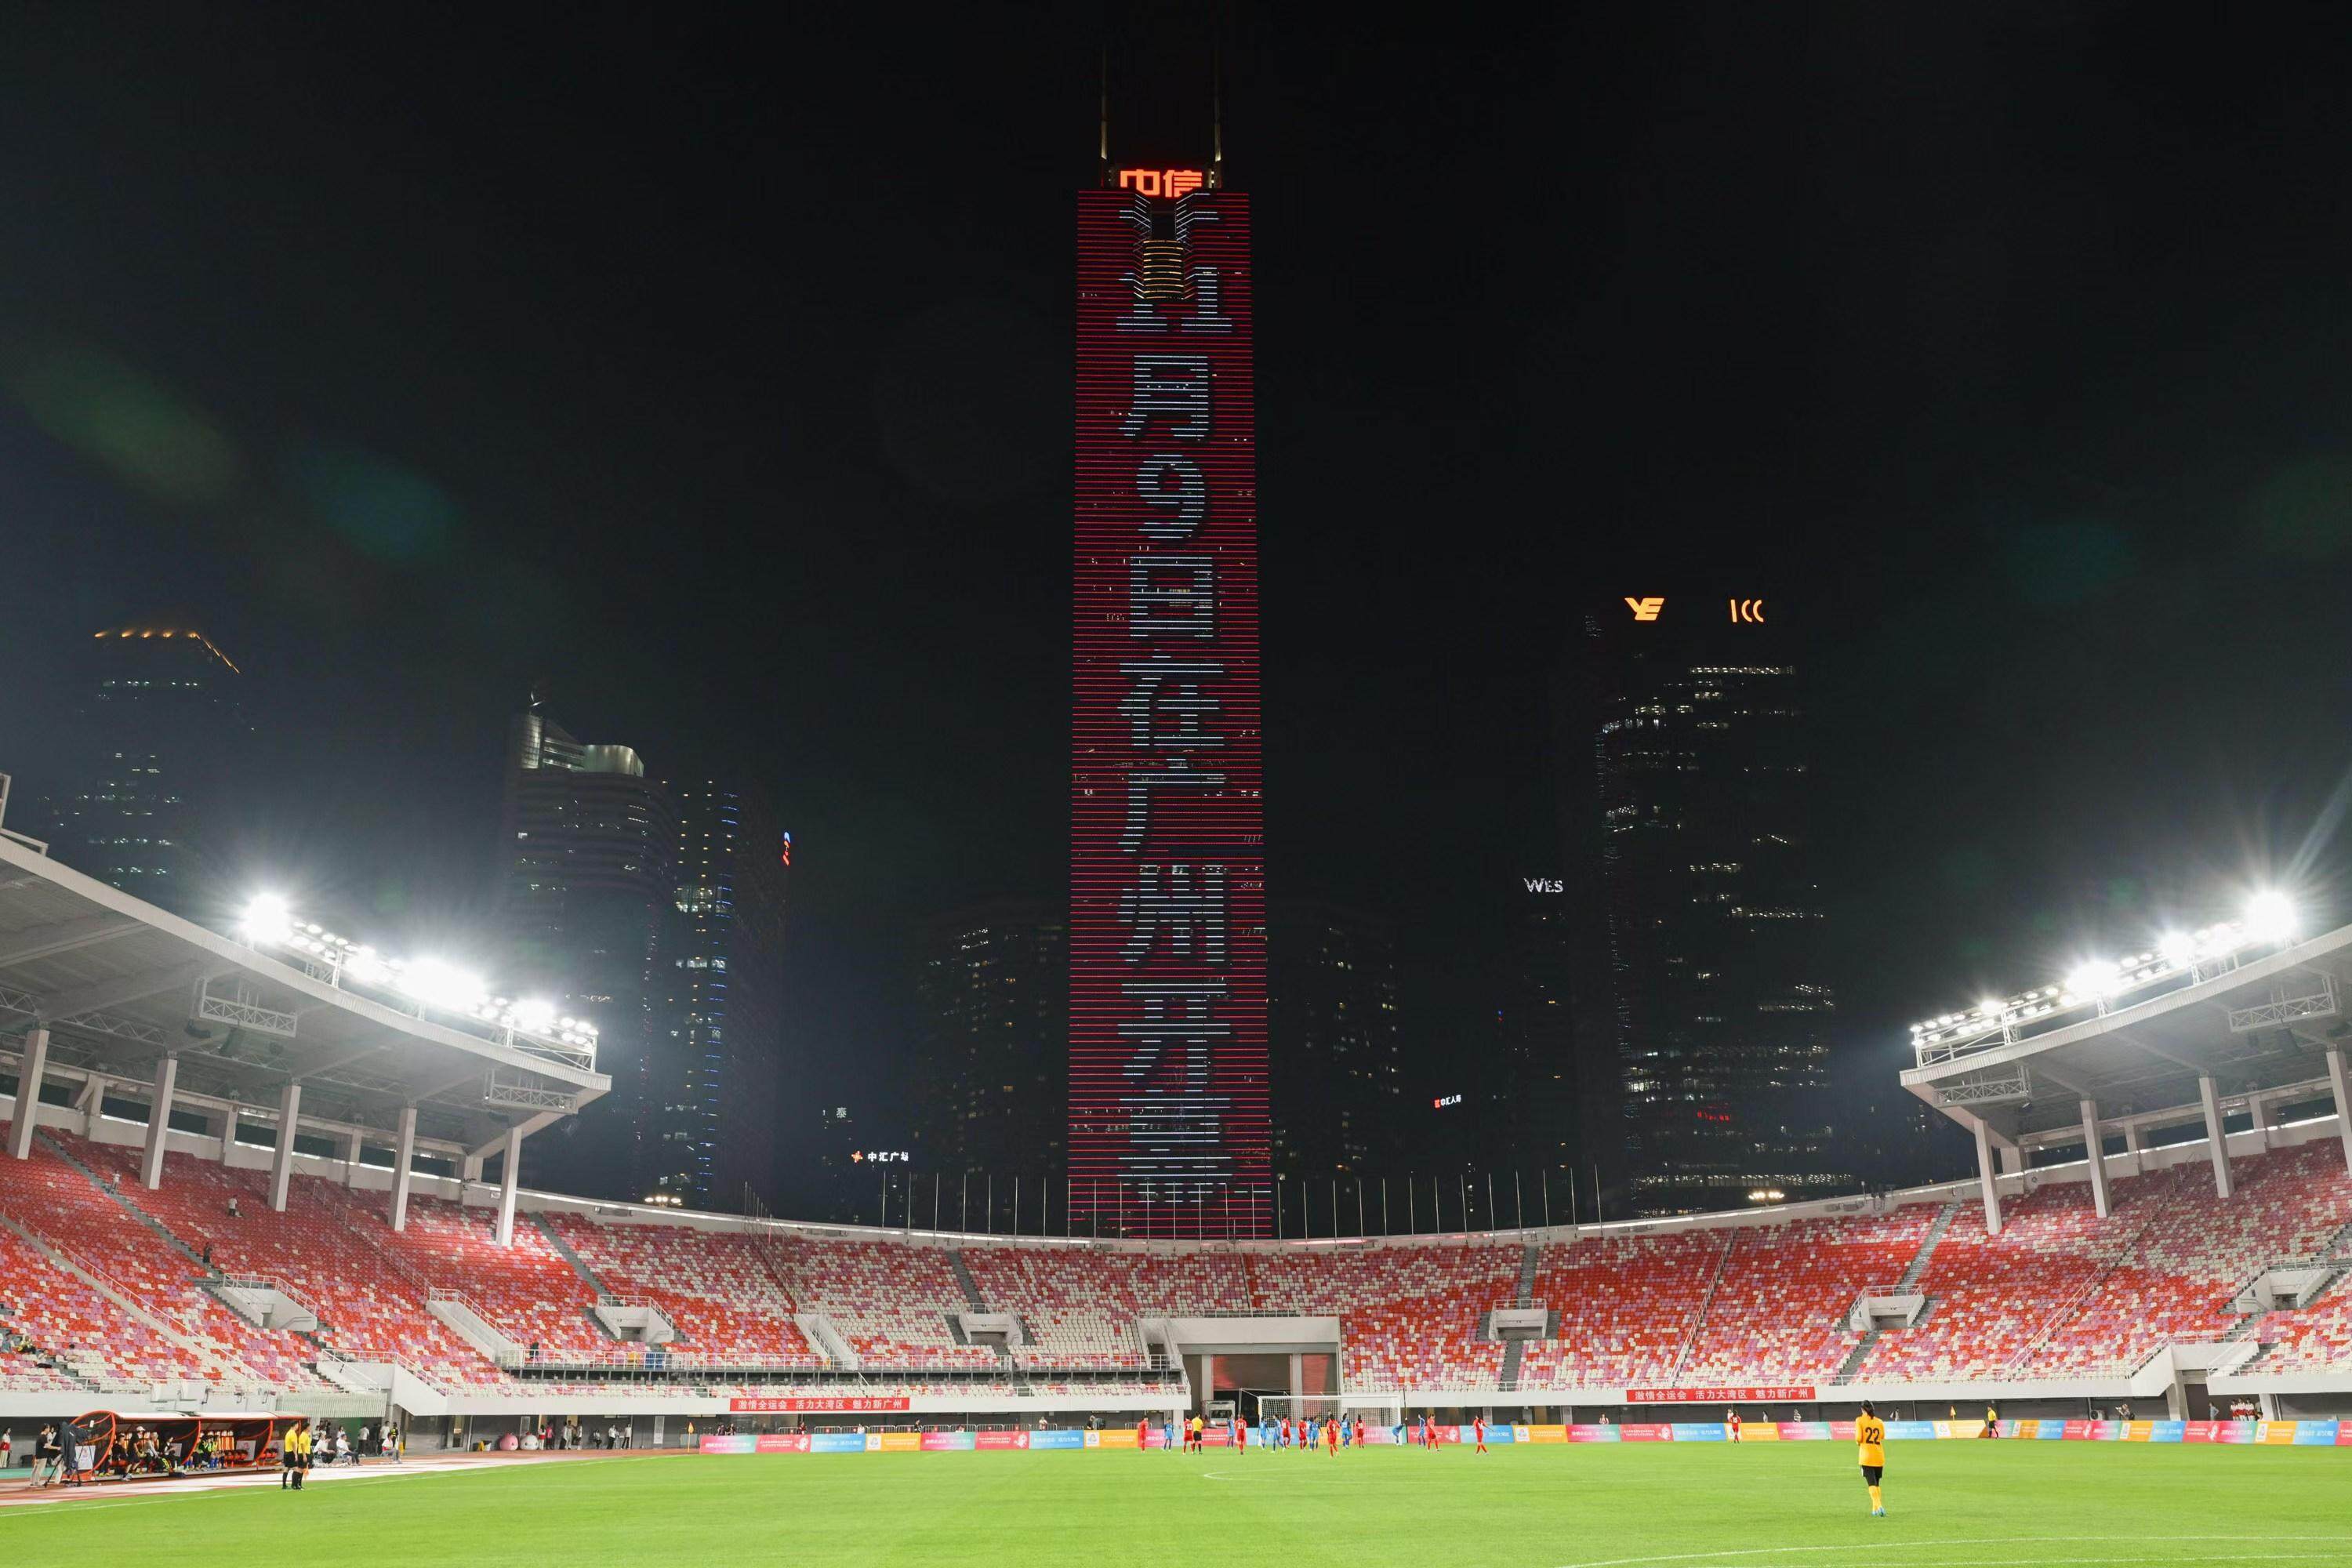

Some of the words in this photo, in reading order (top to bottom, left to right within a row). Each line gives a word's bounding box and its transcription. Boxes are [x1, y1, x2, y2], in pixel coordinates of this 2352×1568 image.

[1119, 169, 1203, 198] 中信
[1730, 599, 1764, 622] ICC
[867, 1151, 909, 1163] 中汇广场
[1635, 1390, 1687, 1401] 激情全运会
[1695, 1389, 1748, 1400] 活力大湾区
[1755, 1388, 1809, 1399] 魅力新广州
[738, 1399, 788, 1410] 激情全运会
[796, 1399, 844, 1410] 活力大湾区
[852, 1399, 902, 1410] 魅力新广州
[1864, 1426, 1881, 1445] 22
